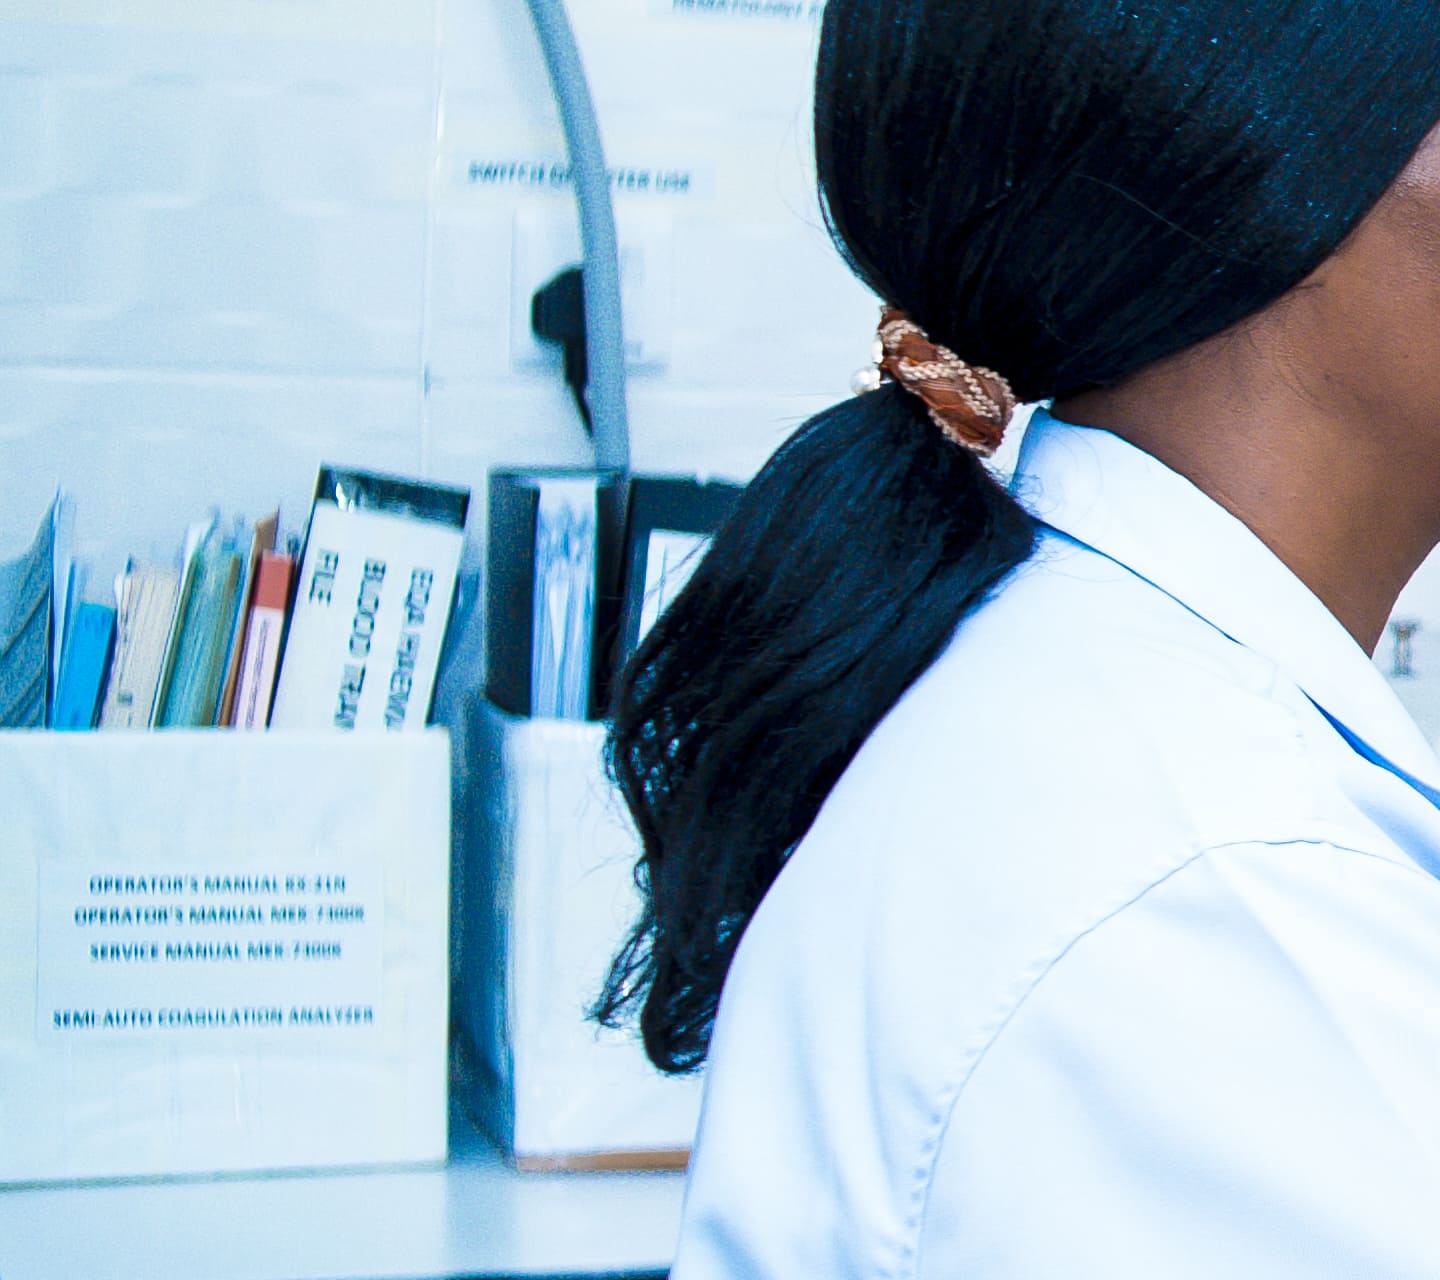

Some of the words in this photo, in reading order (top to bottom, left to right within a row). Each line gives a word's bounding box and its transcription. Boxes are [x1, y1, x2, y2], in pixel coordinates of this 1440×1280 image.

[308, 547, 340, 607] FILE
[349, 558, 387, 659] BLOOD
[203, 874, 279, 896] MANUAL
[188, 904, 264, 926] MANUAL
[89, 940, 160, 962] SERVICE
[165, 940, 241, 962] MANUAL
